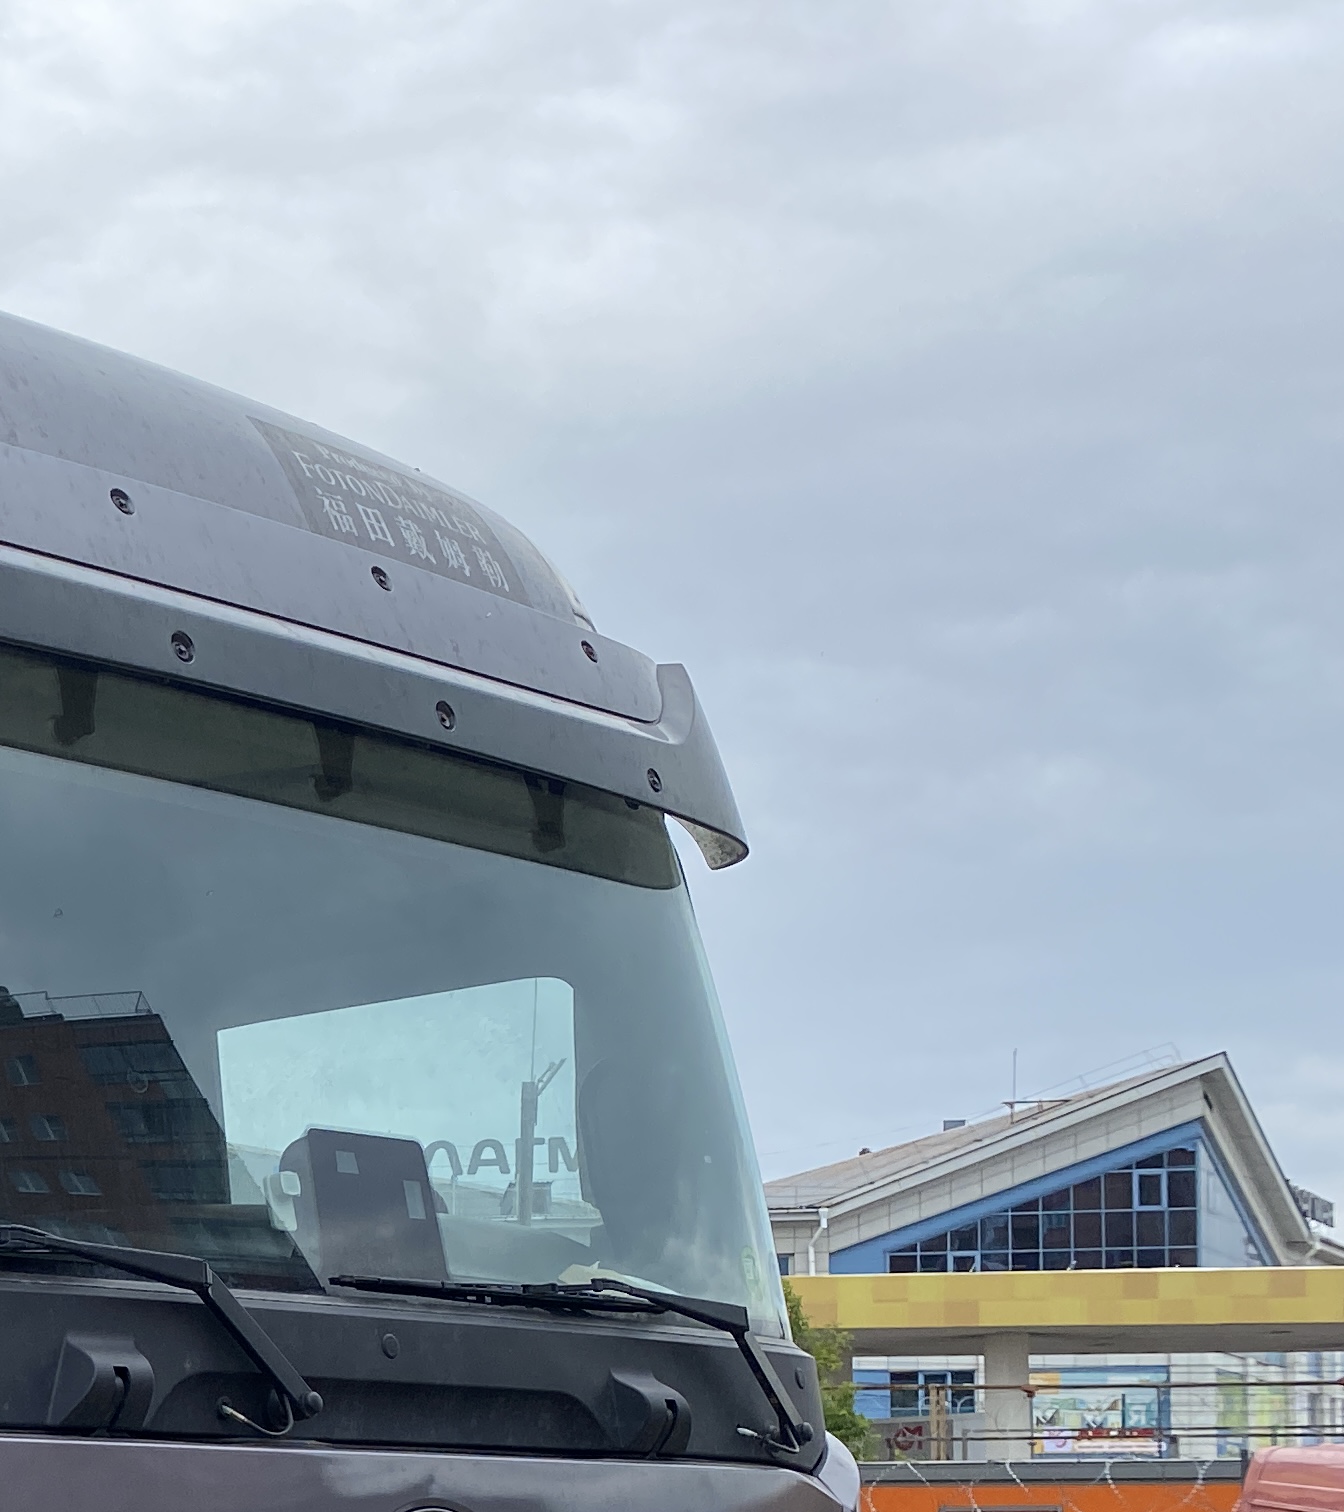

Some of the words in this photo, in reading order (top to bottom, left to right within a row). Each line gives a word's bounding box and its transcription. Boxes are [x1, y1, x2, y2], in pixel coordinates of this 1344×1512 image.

[315, 486, 509, 592] 福田戴姆勒
